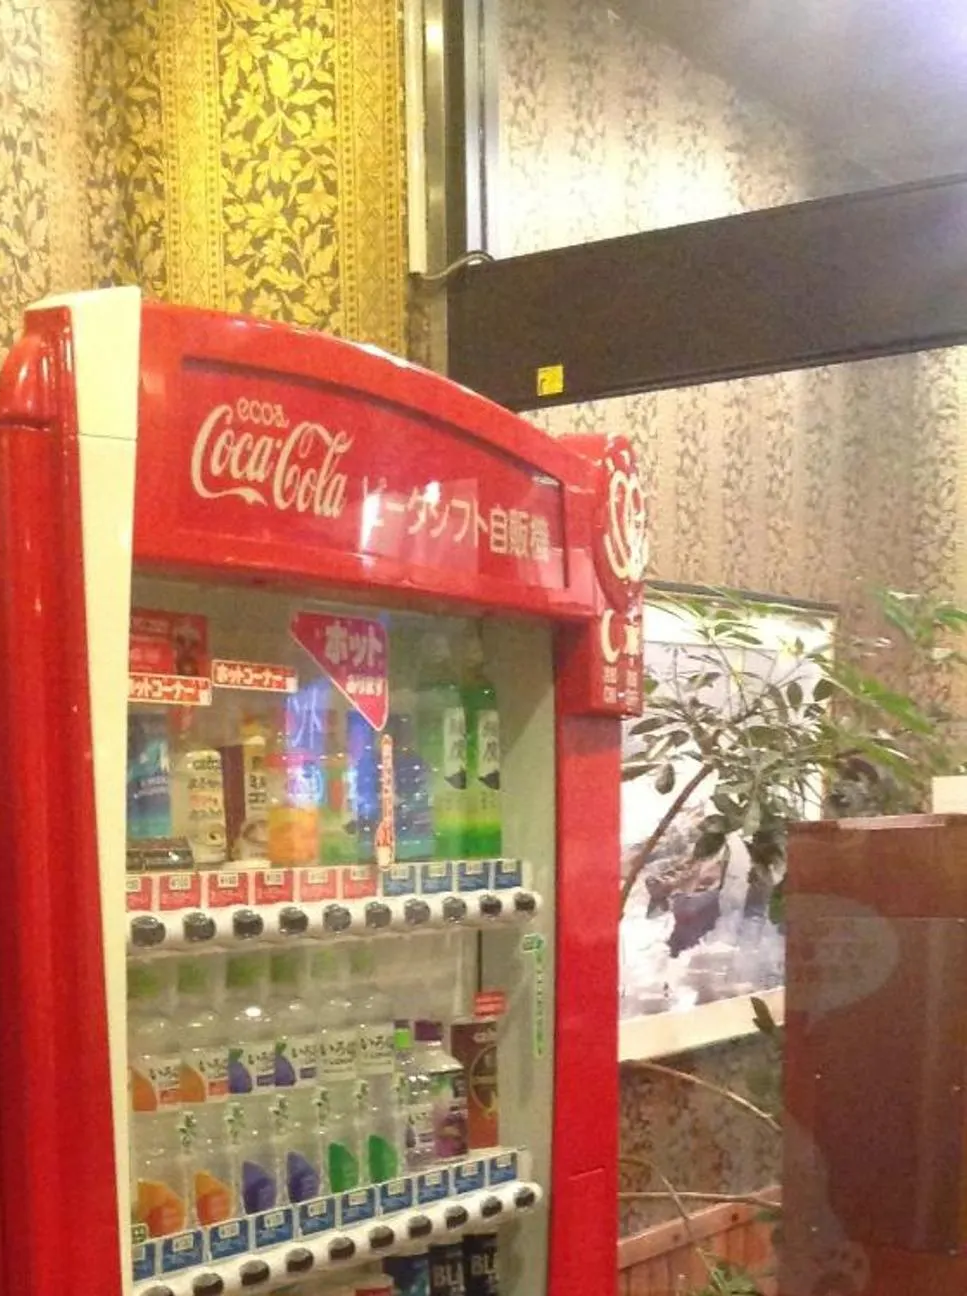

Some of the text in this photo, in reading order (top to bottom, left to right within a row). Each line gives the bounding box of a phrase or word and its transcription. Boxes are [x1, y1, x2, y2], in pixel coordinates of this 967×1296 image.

[191, 404, 354, 519] Coca-Cola
[325, 619, 383, 665] ホット
[129, 676, 195, 699] ットコーナー
[216, 663, 283, 687] ホットコーナー
